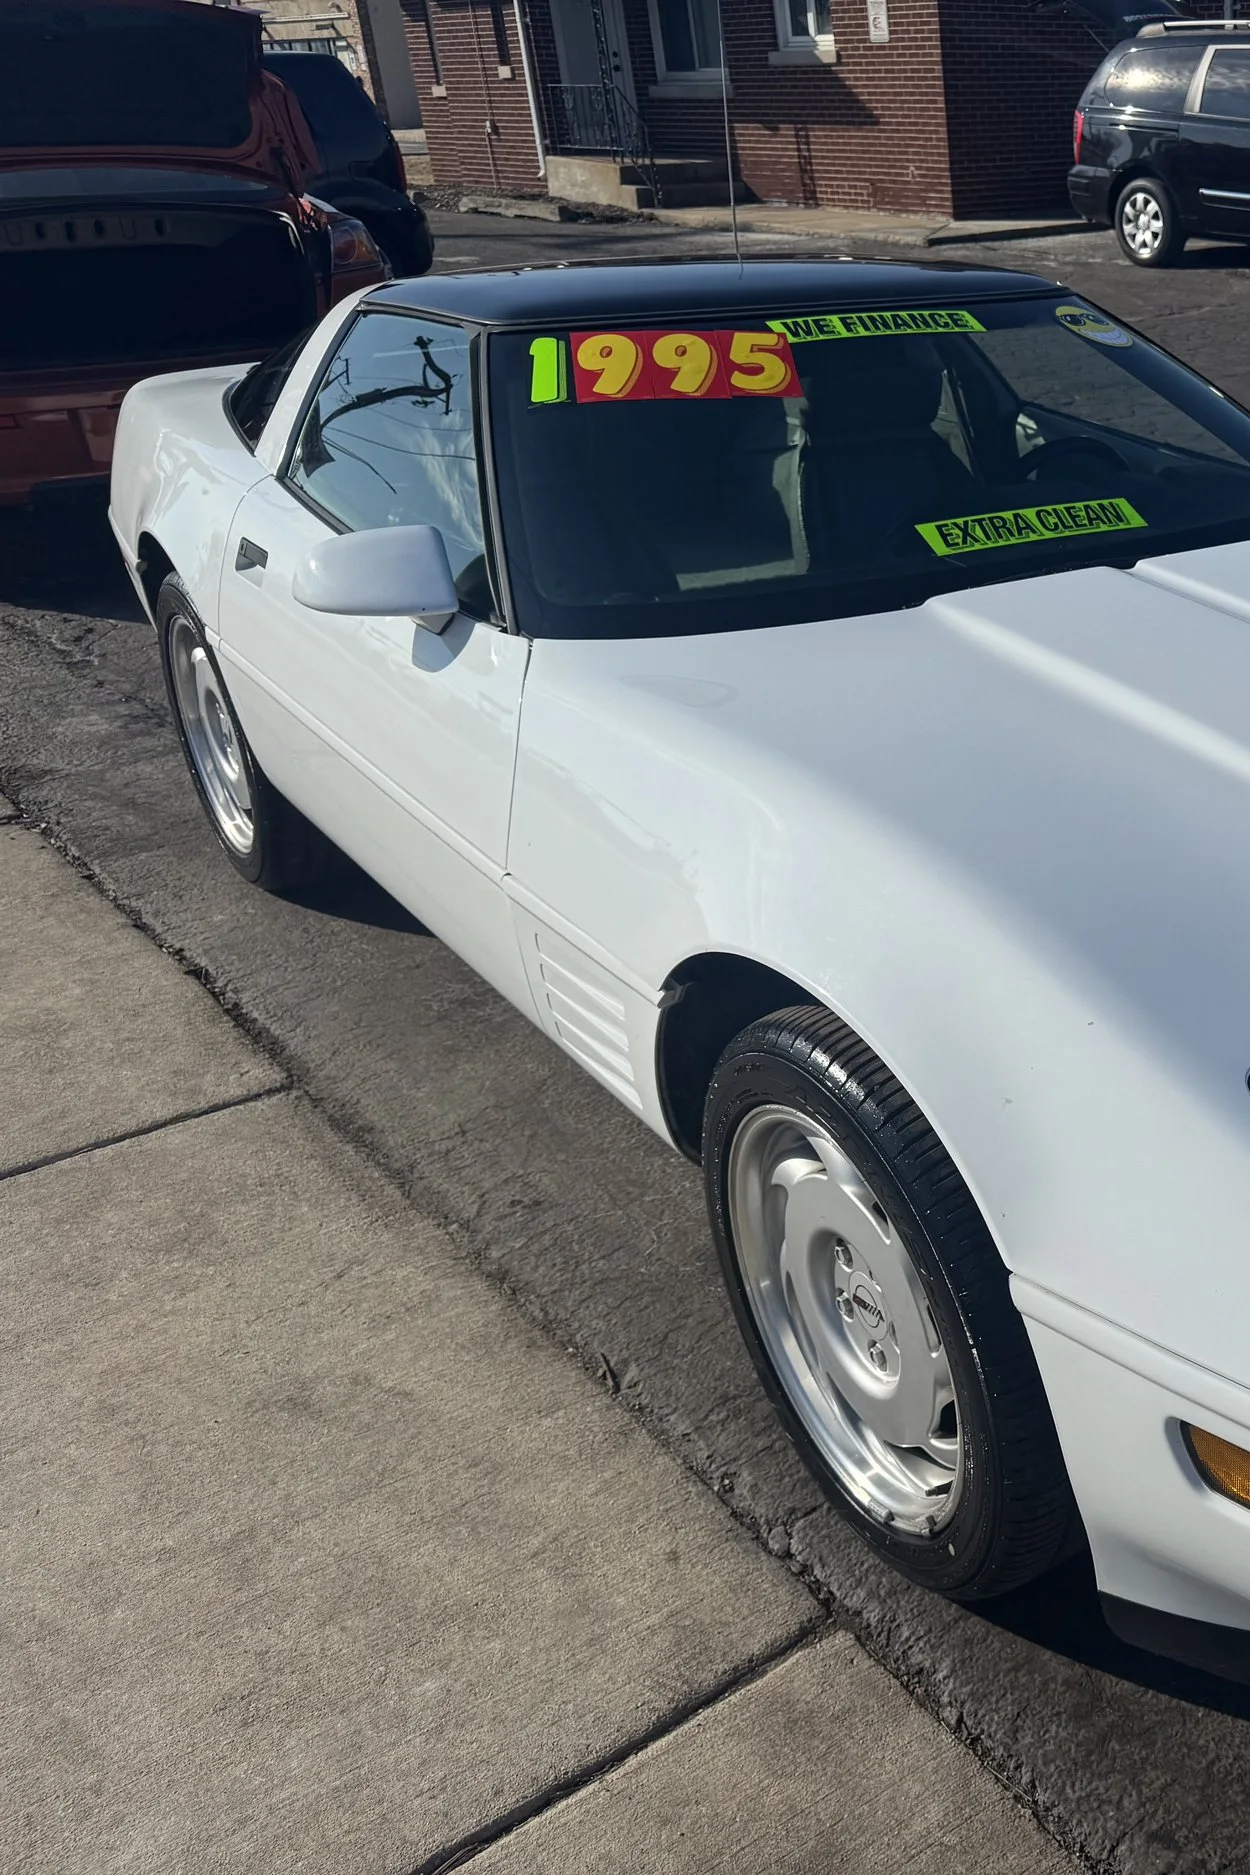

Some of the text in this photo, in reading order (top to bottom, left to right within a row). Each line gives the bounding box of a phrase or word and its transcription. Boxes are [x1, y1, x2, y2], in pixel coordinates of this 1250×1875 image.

[779, 311, 971, 340] WE FINANCE
[529, 332, 792, 404] 1995
[934, 501, 1131, 550] EXTRA CLEAN
